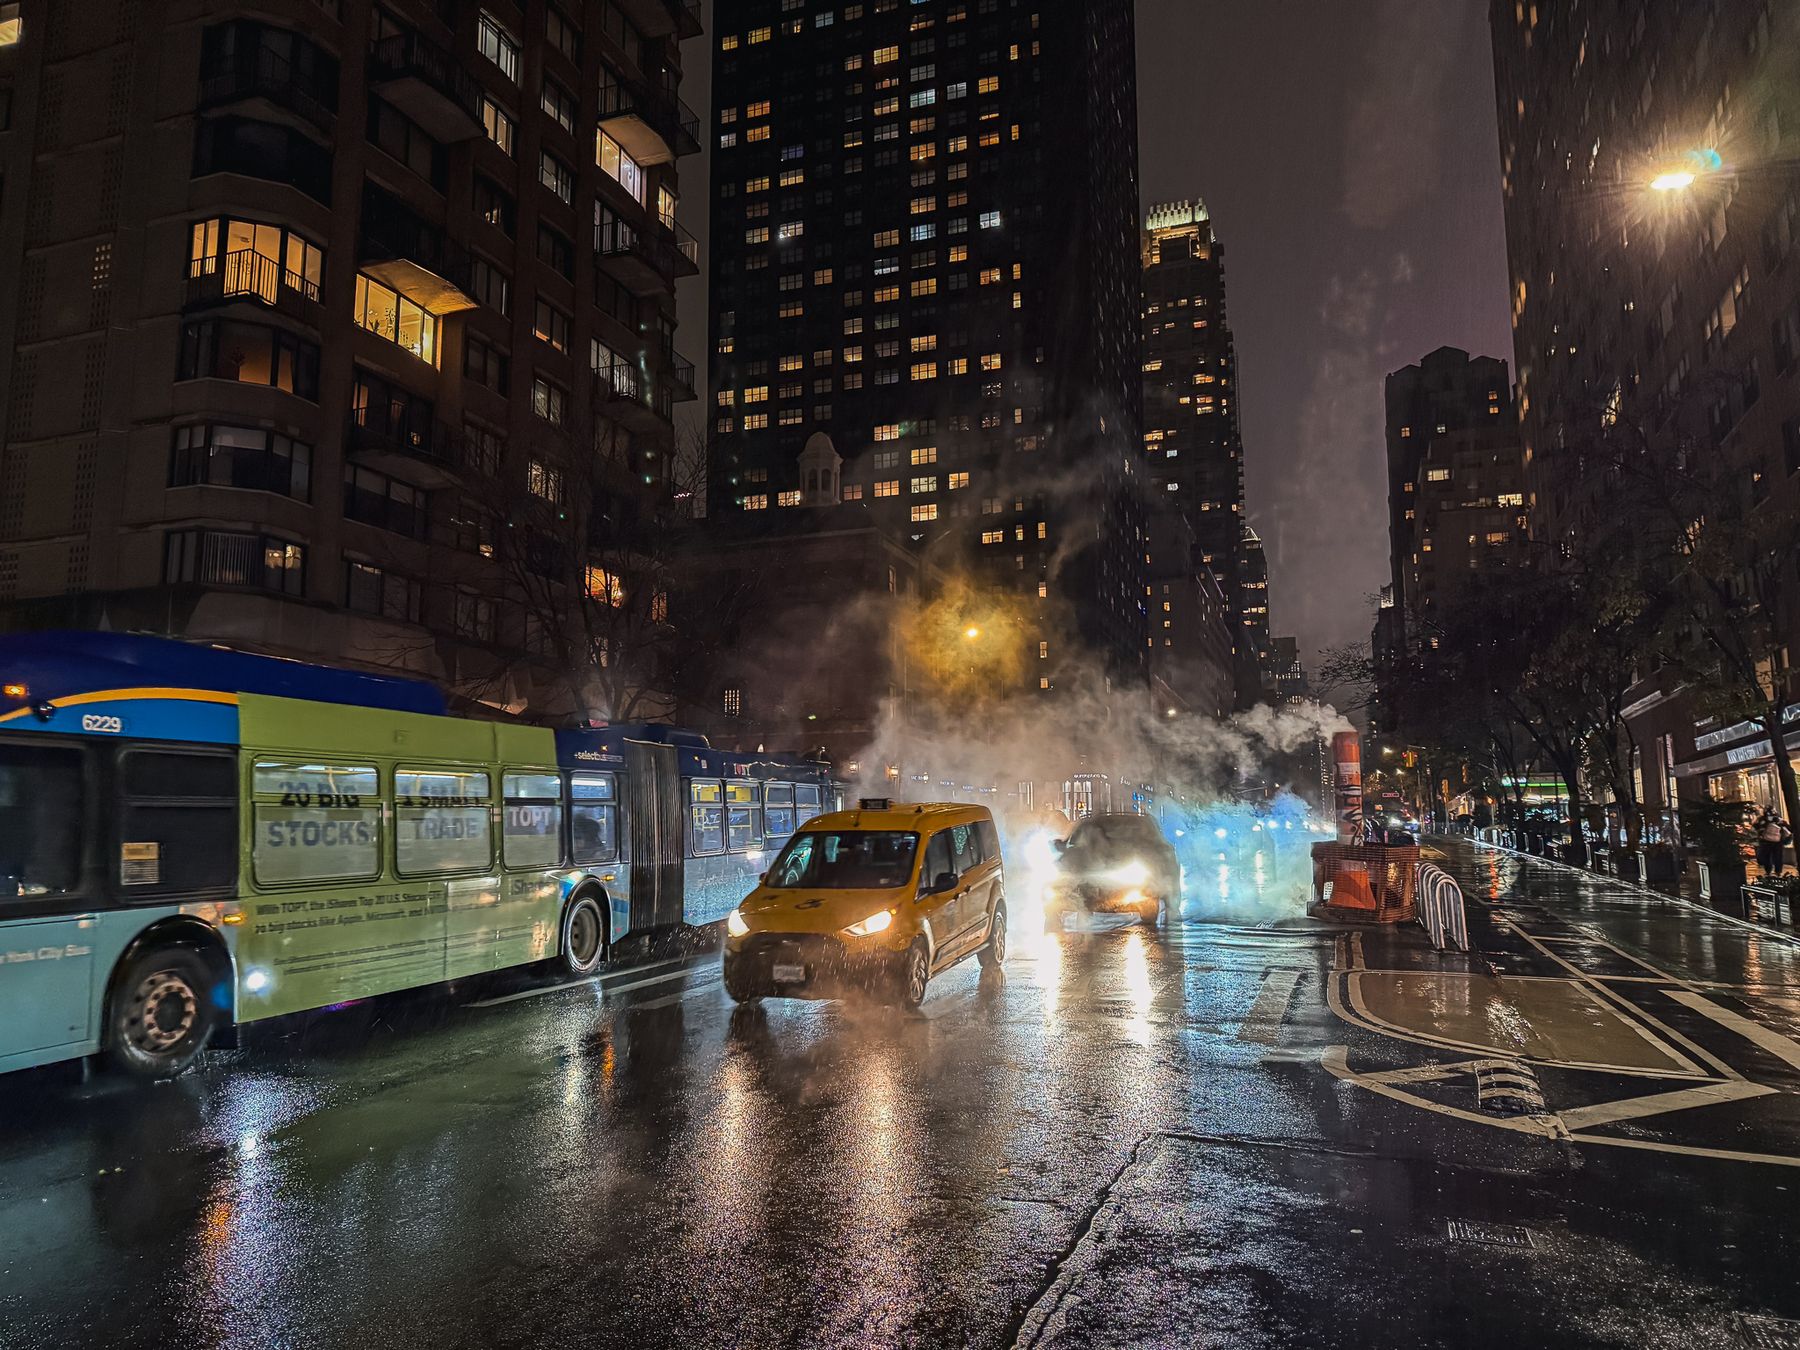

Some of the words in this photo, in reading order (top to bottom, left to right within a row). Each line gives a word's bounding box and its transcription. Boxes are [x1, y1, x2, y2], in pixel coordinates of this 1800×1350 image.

[82, 714, 122, 732] 6229
[279, 781, 310, 806] 20
[317, 782, 360, 808] BIG
[509, 806, 552, 827] TOPT
[267, 820, 370, 847] STOCKS
[414, 817, 479, 839] TRADE
